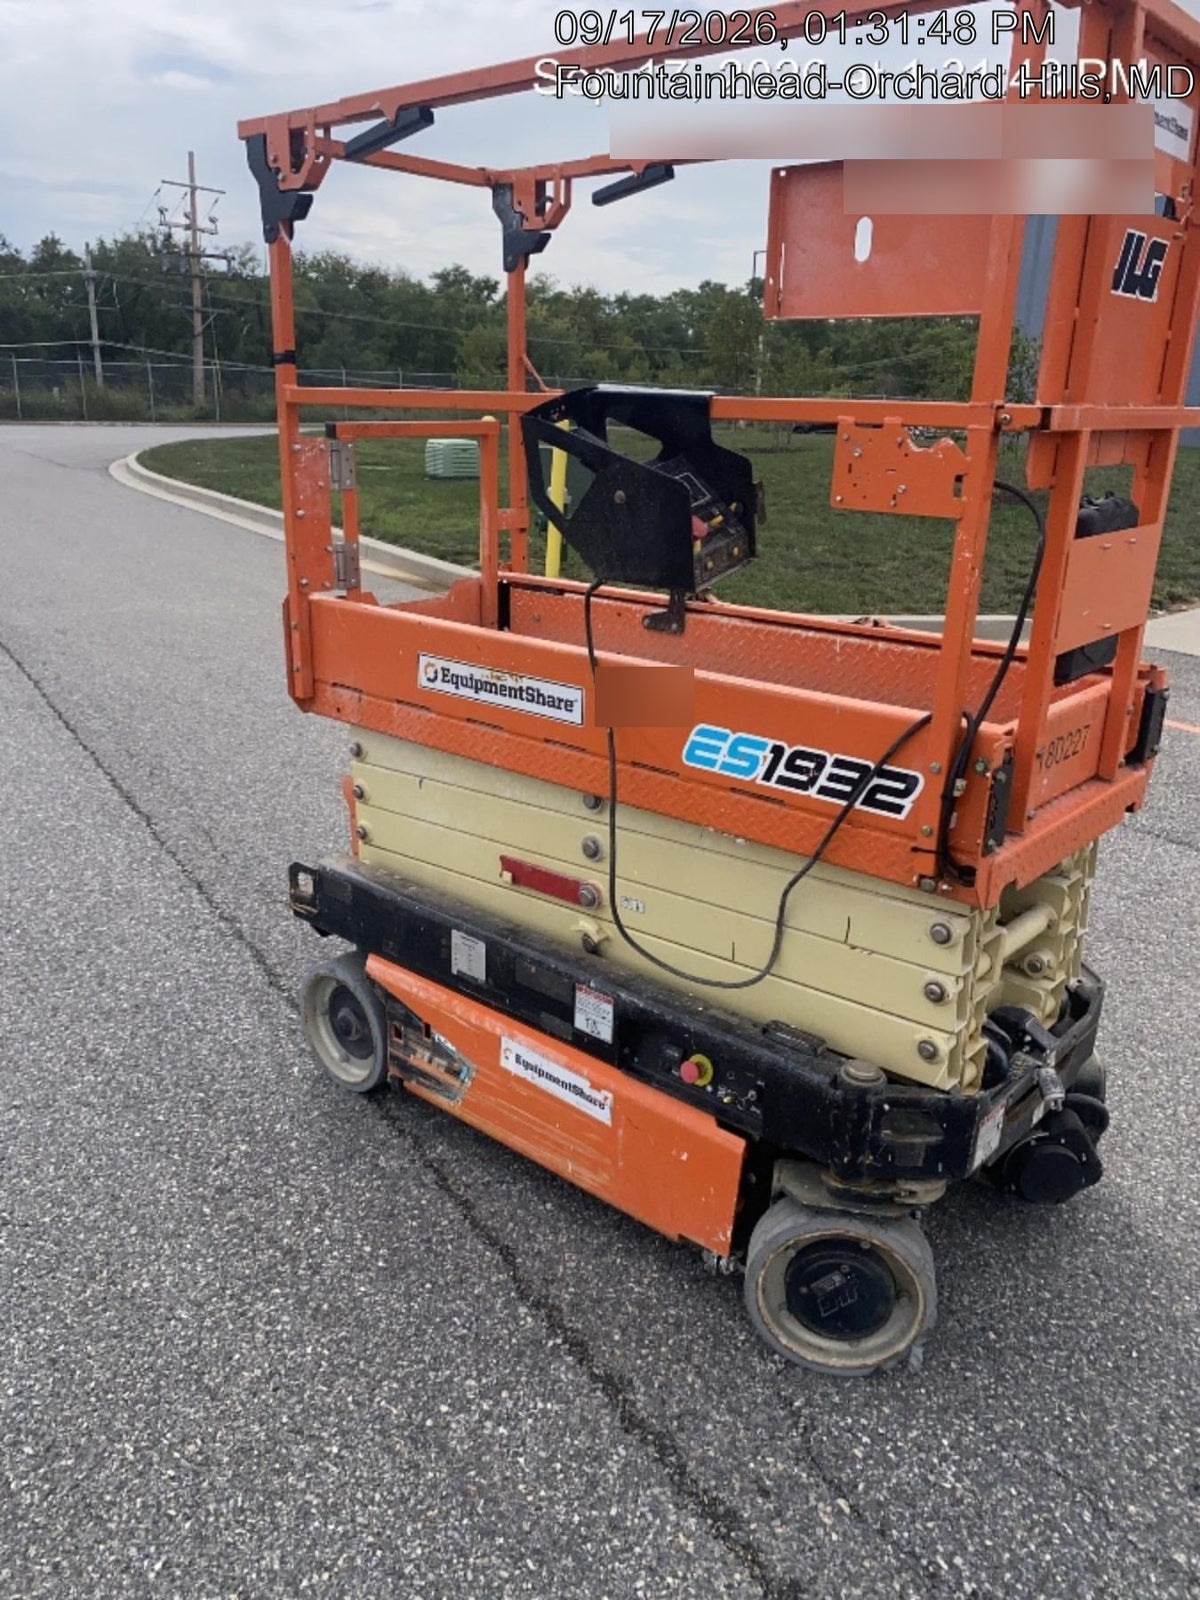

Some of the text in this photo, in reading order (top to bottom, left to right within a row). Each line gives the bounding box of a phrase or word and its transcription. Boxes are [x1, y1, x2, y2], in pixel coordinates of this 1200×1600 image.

[1111, 229, 1169, 303] JLG
[440, 666, 576, 713] EquipmentShare
[682, 723, 925, 819] ES1932
